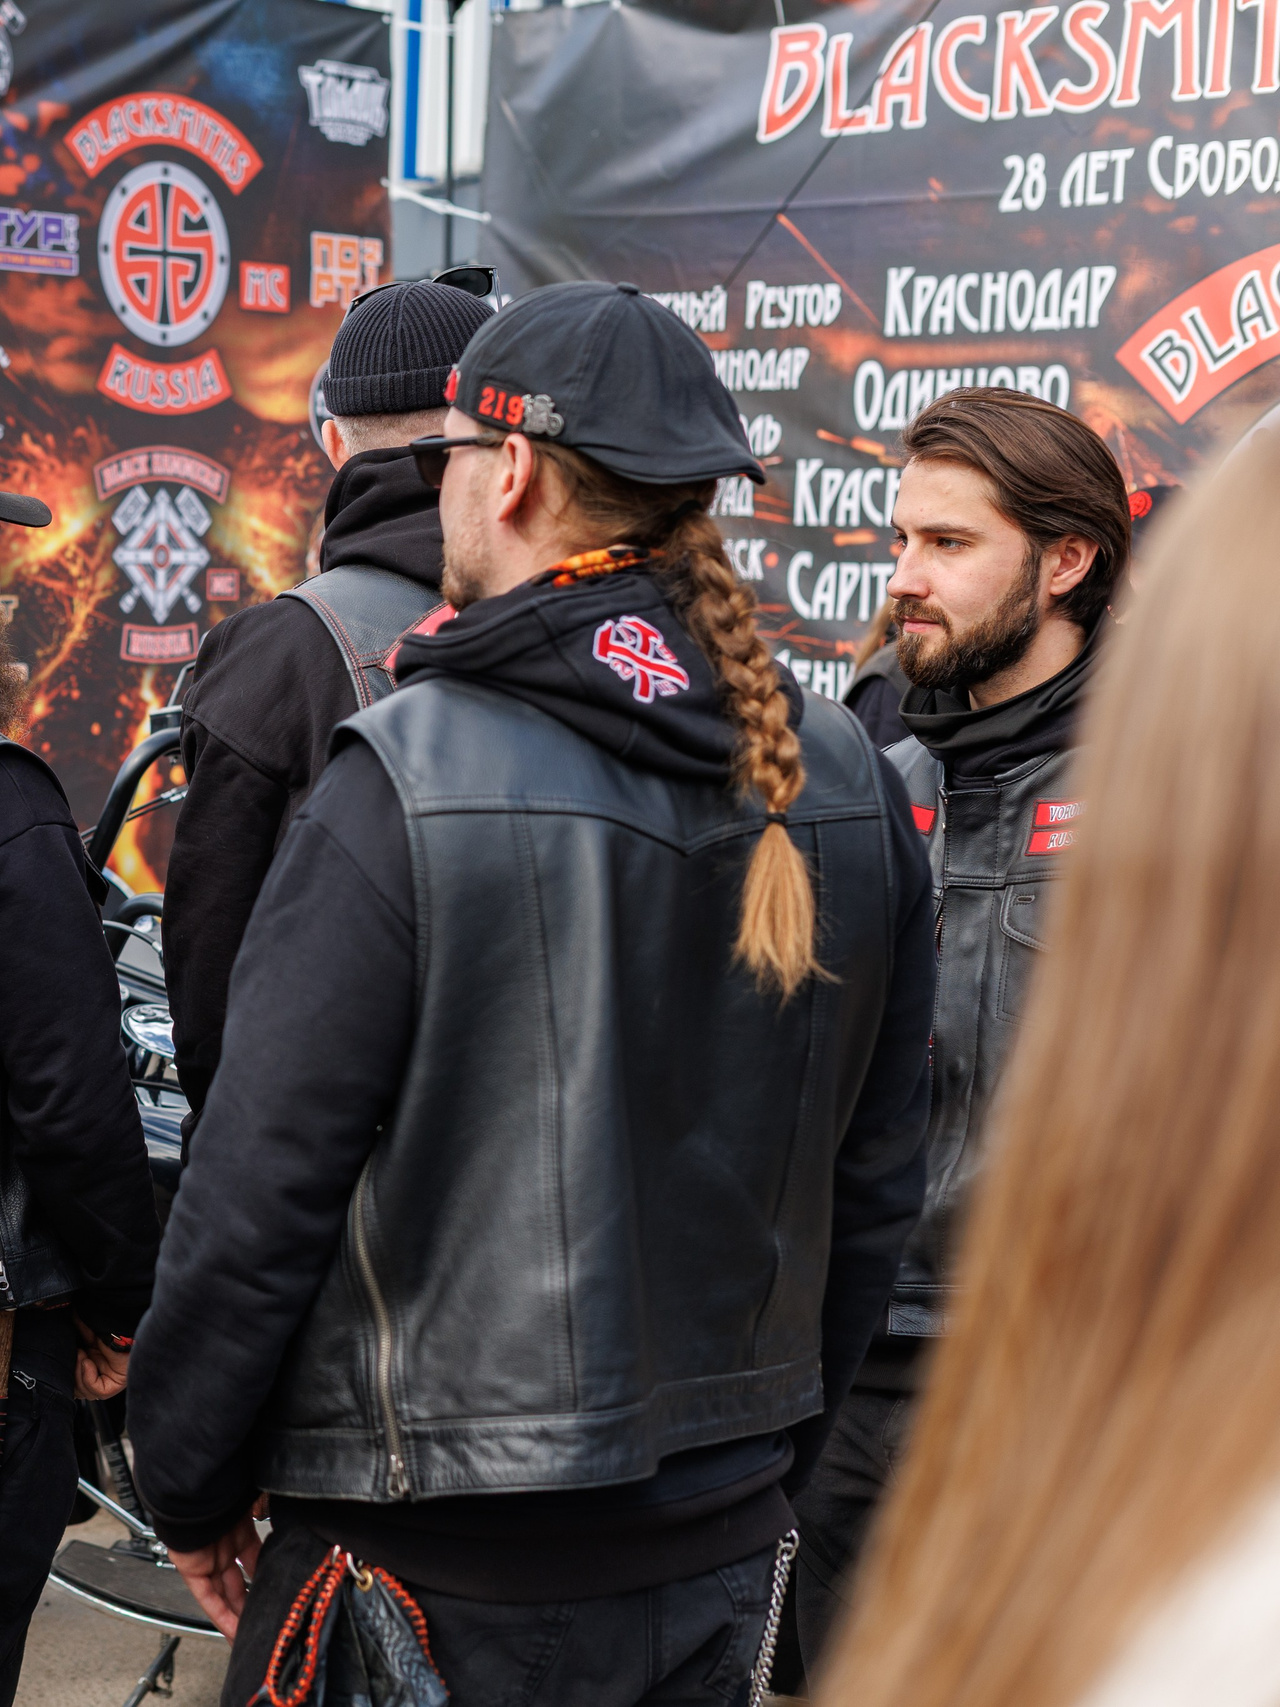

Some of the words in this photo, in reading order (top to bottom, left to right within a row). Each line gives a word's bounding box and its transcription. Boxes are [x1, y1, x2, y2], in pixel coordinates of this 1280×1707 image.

[72, 98, 252, 185] BLACKSMITHS
[998, 153, 1047, 213] 28
[1146, 135, 1280, 200] СВОБО
[245, 266, 287, 308] MC
[105, 353, 222, 408] RUSSIA
[478, 386, 525, 426] 219
